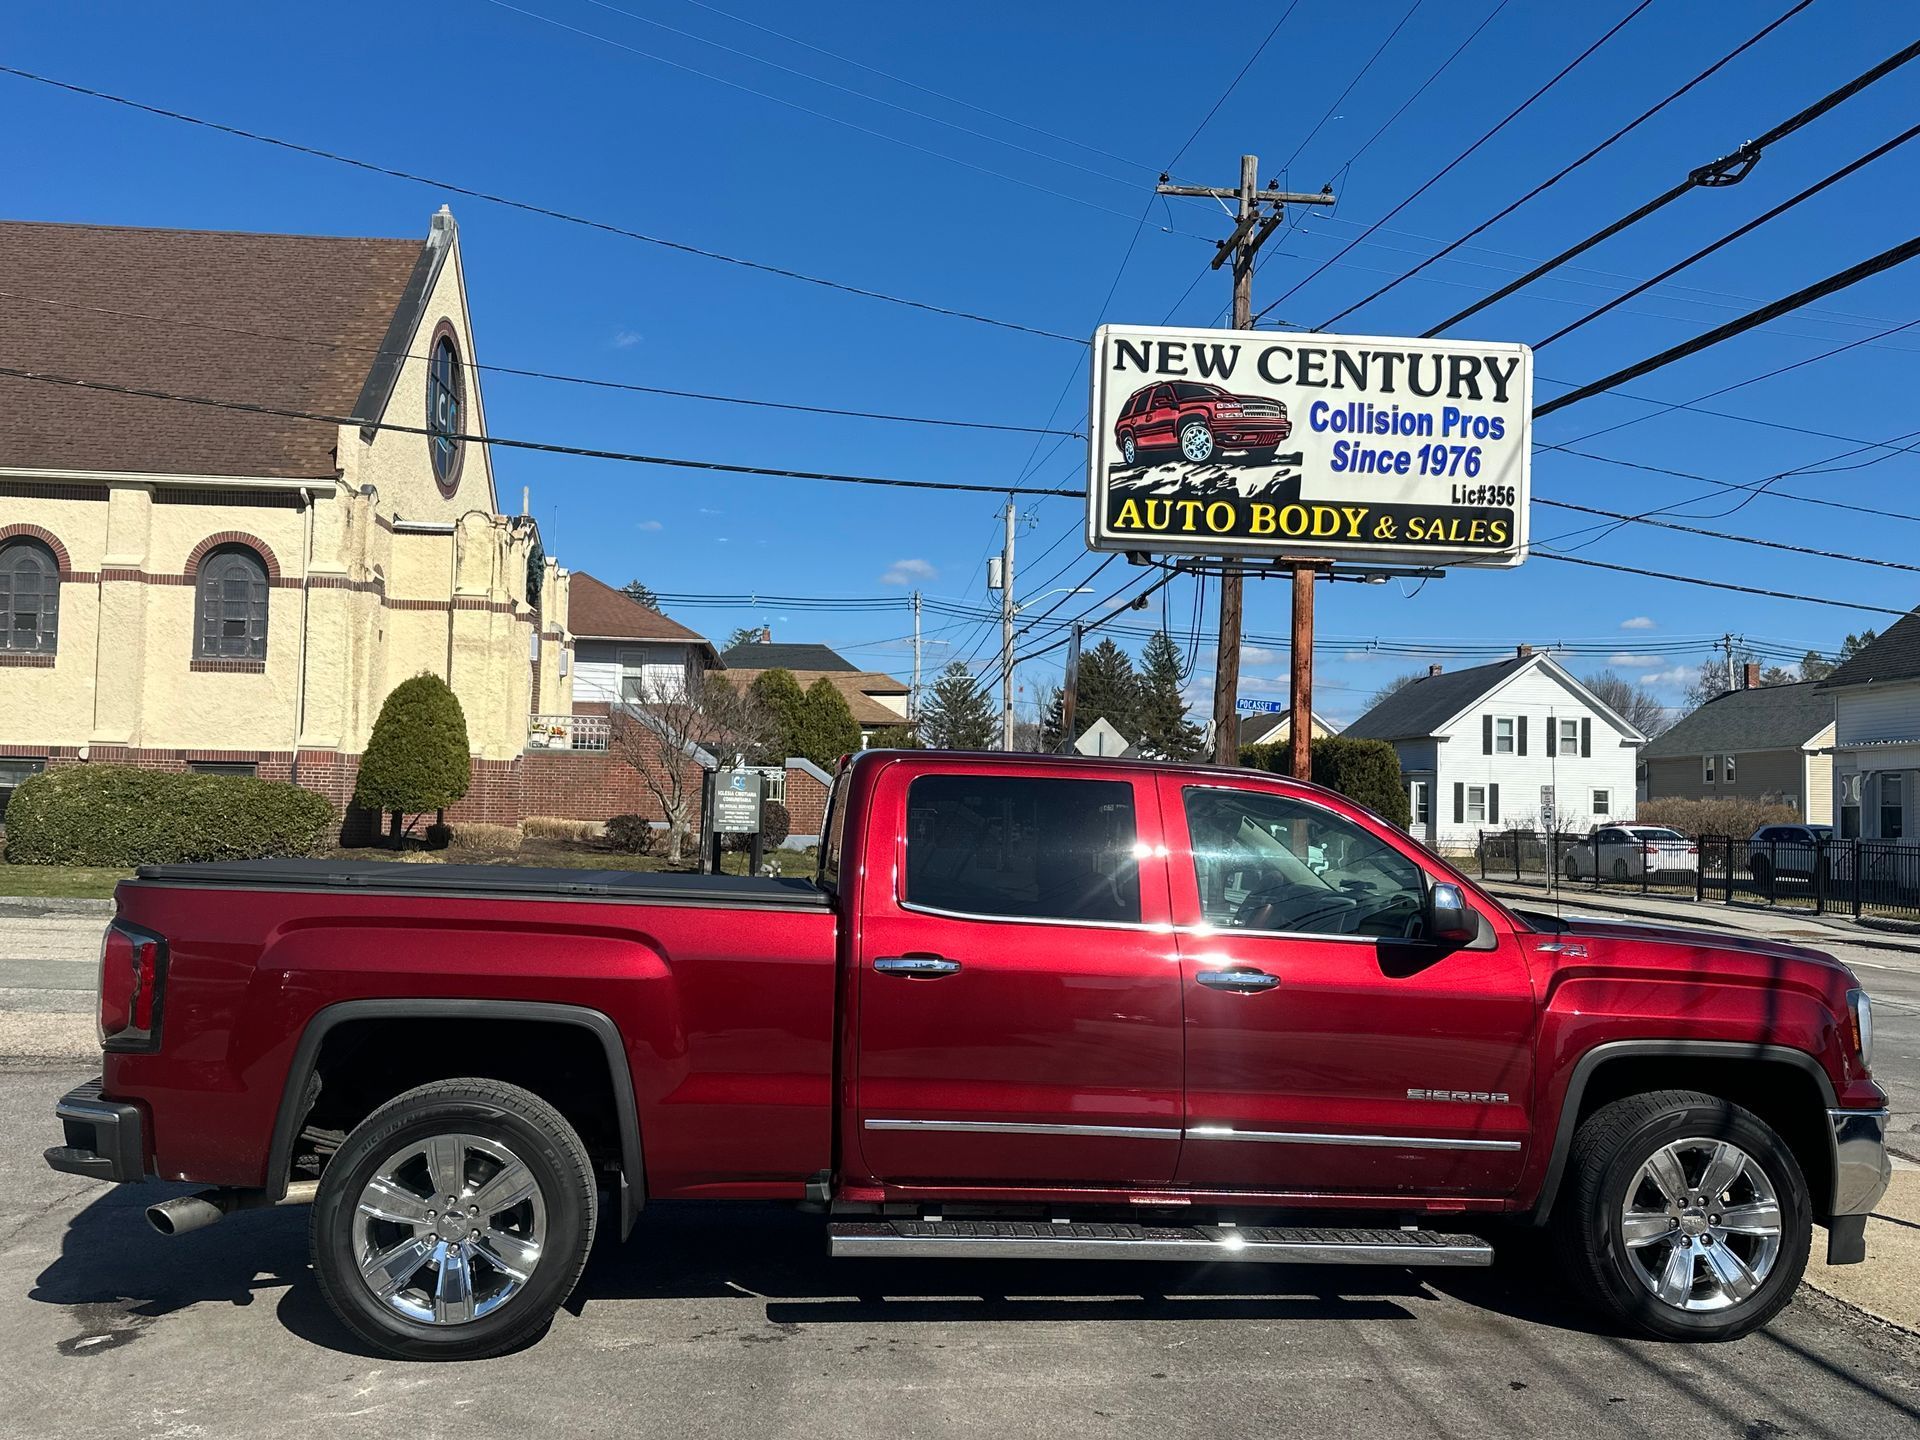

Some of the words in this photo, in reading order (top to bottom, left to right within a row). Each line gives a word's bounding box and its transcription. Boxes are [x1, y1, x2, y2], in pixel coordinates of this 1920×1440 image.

[1112, 339, 1241, 380] NEW
[1257, 344, 1520, 403] CENTURY
[1308, 400, 1433, 437] Collision
[1441, 407, 1506, 441] Pros
[1330, 440, 1411, 475] Since
[1417, 443, 1481, 478] 1976
[1451, 483, 1515, 507] Lic#356
[1113, 498, 1236, 533] AUTO
[1248, 503, 1370, 539] BODY
[1373, 518, 1399, 540] &
[1404, 516, 1508, 544] SALES
[1239, 699, 1273, 711] POCASSET
[1406, 1088, 1510, 1104] SIERRA
